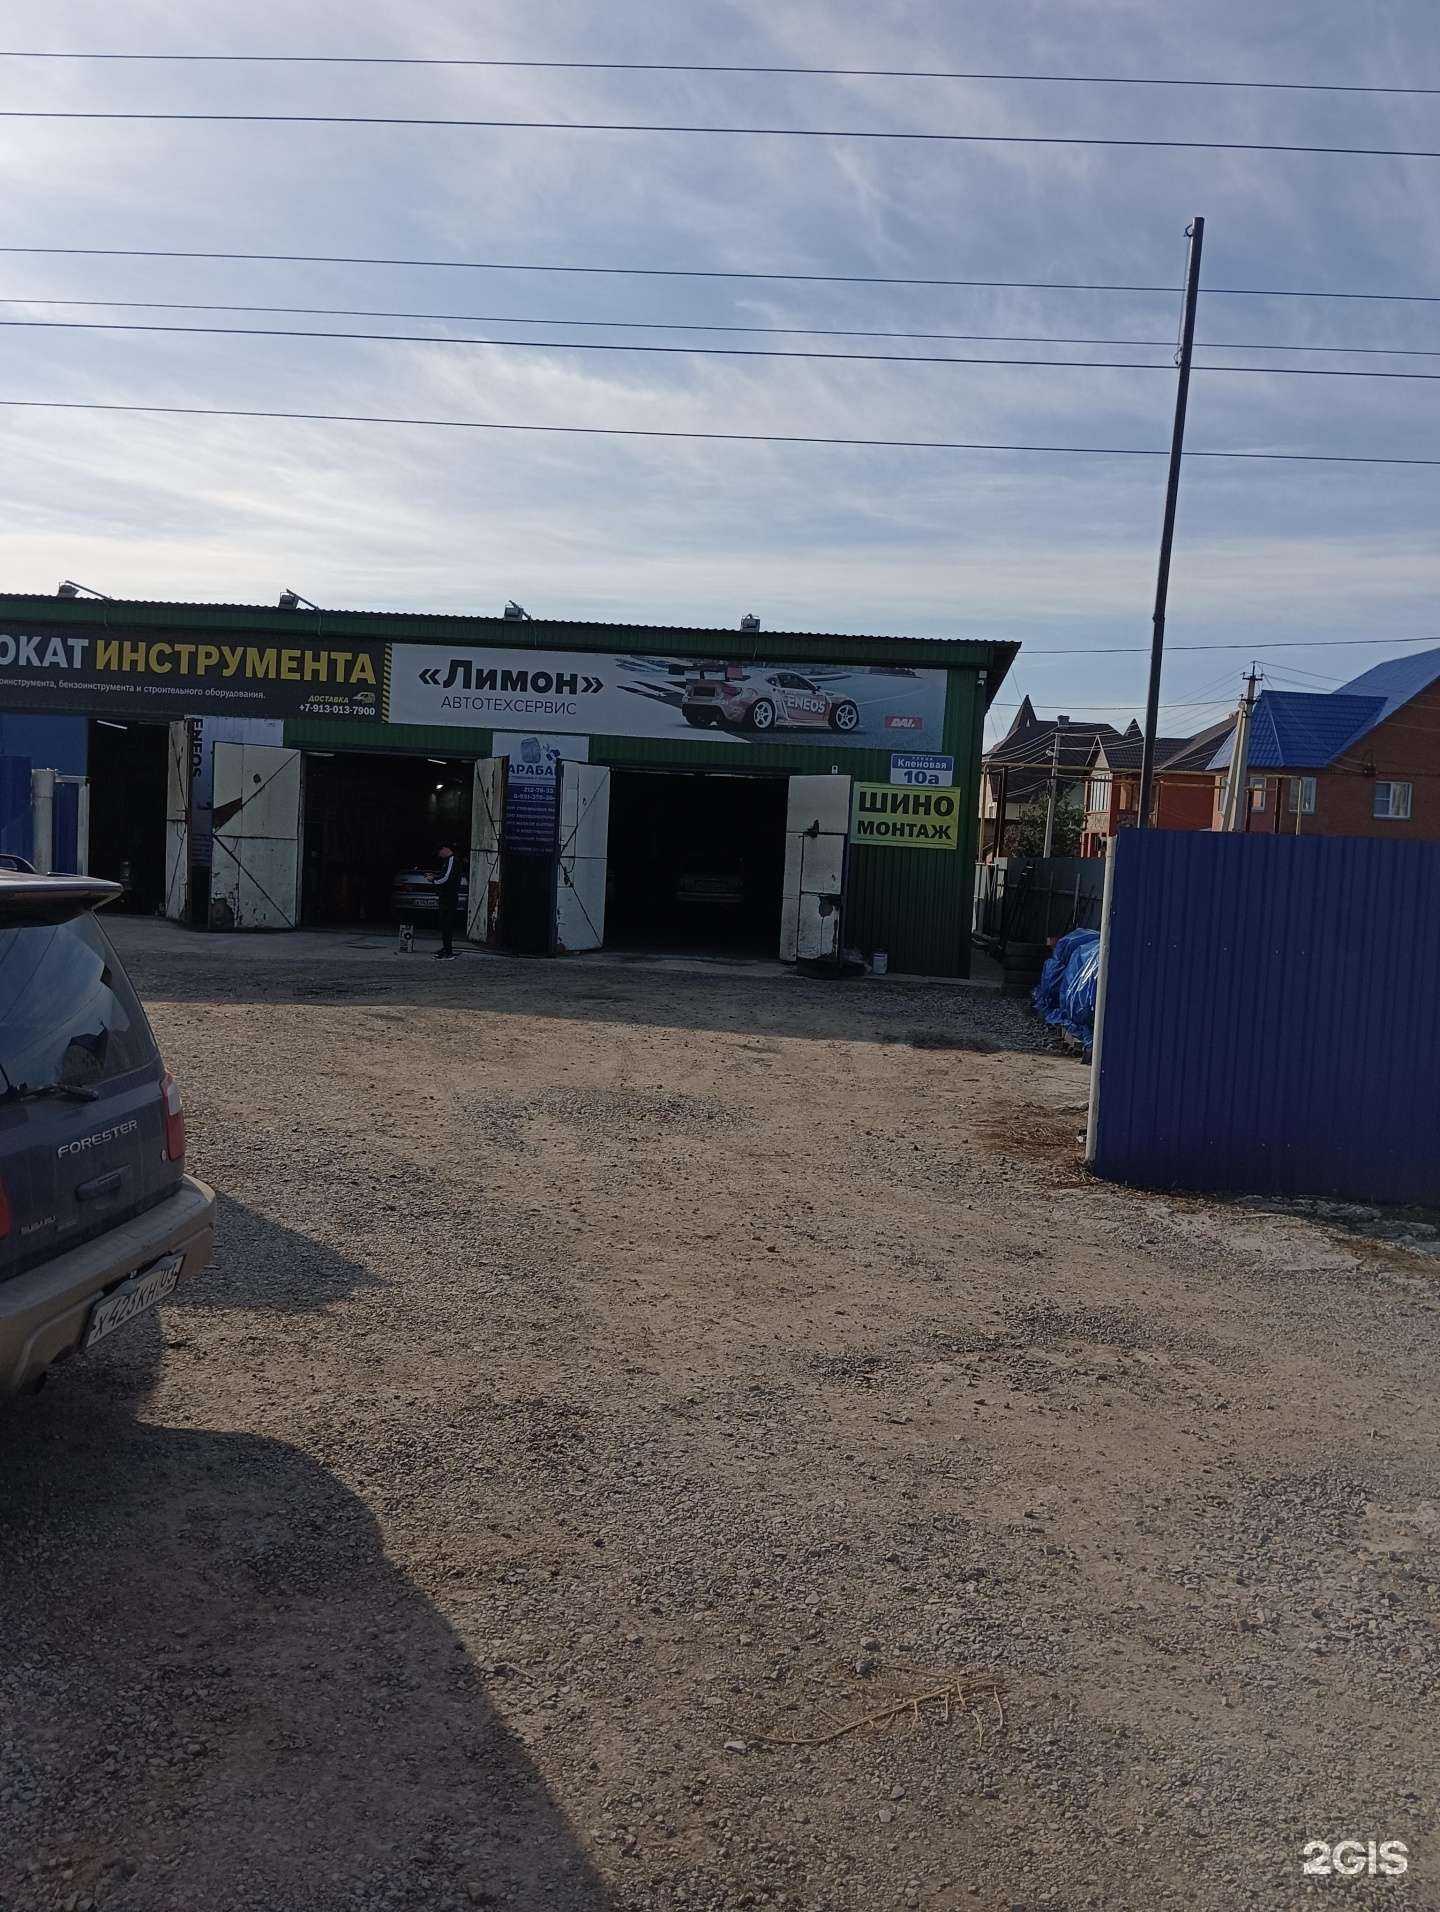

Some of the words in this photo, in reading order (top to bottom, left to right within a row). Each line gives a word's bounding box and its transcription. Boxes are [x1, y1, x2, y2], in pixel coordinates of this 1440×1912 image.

[0, 634, 88, 669] ОКАТ
[95, 639, 377, 685] ИНСТРУМЕНТА
[418, 659, 604, 695] «Лимон»
[143, 686, 203, 697] строительного
[308, 695, 349, 703] ДОСТАВКА
[299, 703, 376, 715] +7-913-013-7900
[441, 696, 577, 716] АВТОТЕХСЕРВИС
[786, 697, 826, 714] ENEOS
[507, 764, 557, 776] АРАБА
[897, 758, 947, 769] Кленовая
[904, 770, 940, 785] 10а
[859, 791, 954, 817] ШИНО
[857, 820, 952, 840] МОНТАЖ
[57, 1119, 138, 1160] FORESTER
